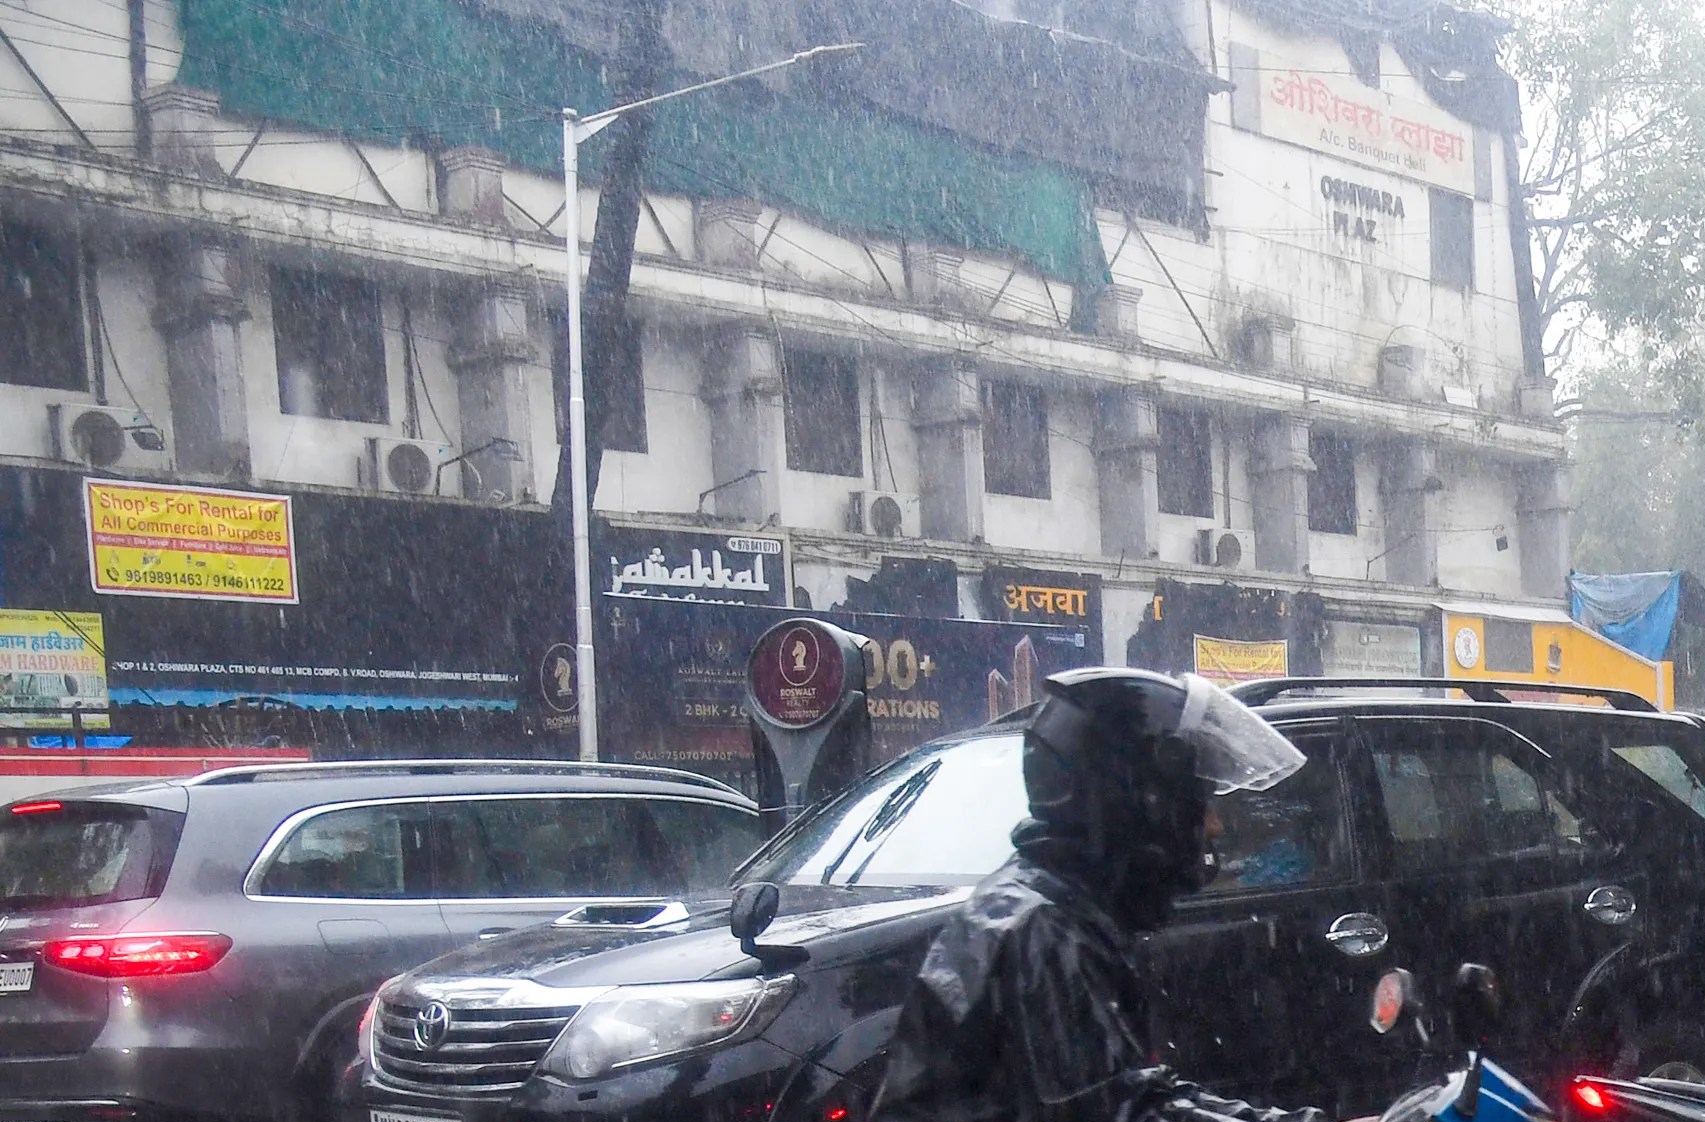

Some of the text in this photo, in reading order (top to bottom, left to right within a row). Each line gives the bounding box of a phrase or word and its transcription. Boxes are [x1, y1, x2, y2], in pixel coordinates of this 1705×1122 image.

[1348, 136, 1400, 164] Banquet
[1320, 175, 1405, 219] OSHIWARA
[100, 492, 279, 522] Shop's For Rental for
[101, 515, 281, 541] All Commercial Purposes
[1003, 584, 1087, 617] अजवा
[17, 654, 100, 672] HARDWARE
[142, 662, 148, 671] &
[158, 662, 200, 673] OSHIWARA
[780, 687, 817, 697] ROSWALT
[685, 704, 693, 716] 2
[695, 704, 720, 716] BHK
[546, 715, 579, 730] ROSWA
